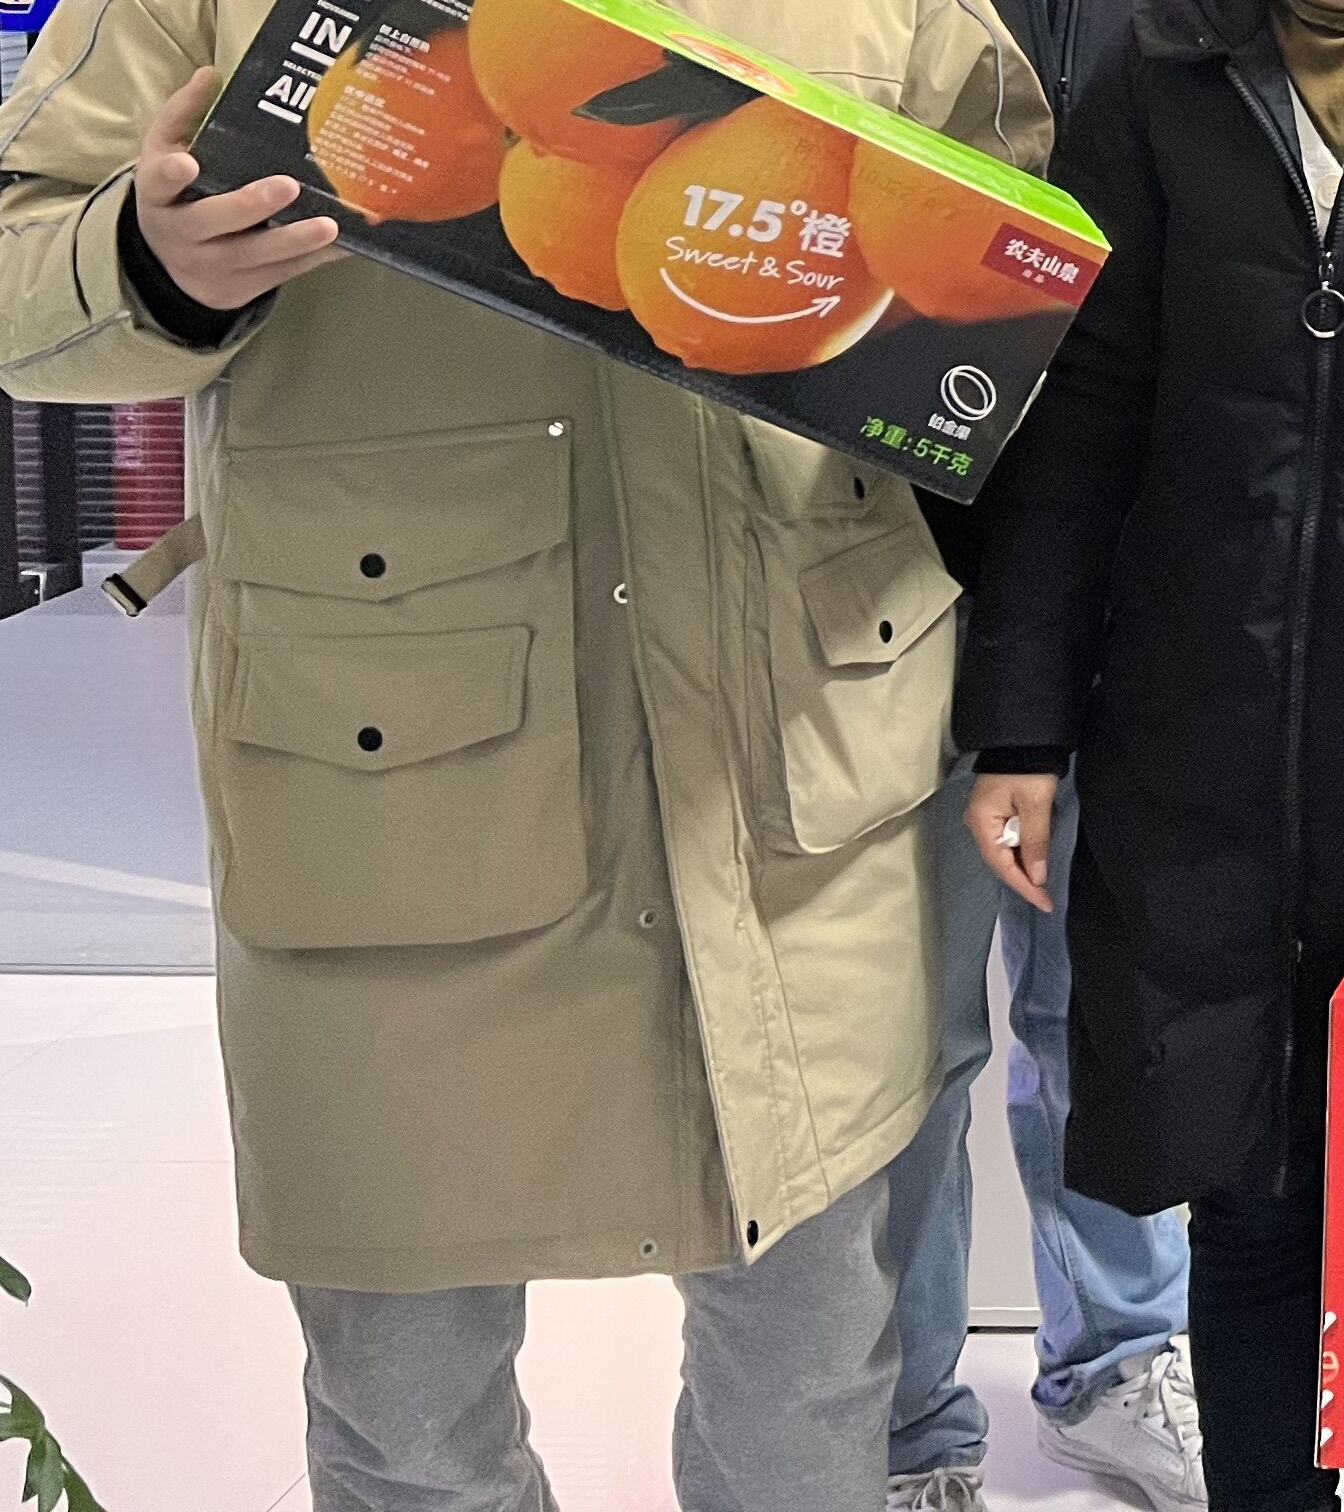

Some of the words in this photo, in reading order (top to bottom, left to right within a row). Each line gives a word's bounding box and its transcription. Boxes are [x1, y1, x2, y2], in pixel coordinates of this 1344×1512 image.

[298, 11, 353, 54] IN
[665, 236, 756, 277] Sweet
[759, 256, 782, 278] &
[785, 261, 844, 290] Sour
[1004, 238, 1080, 284] 农夫山泉
